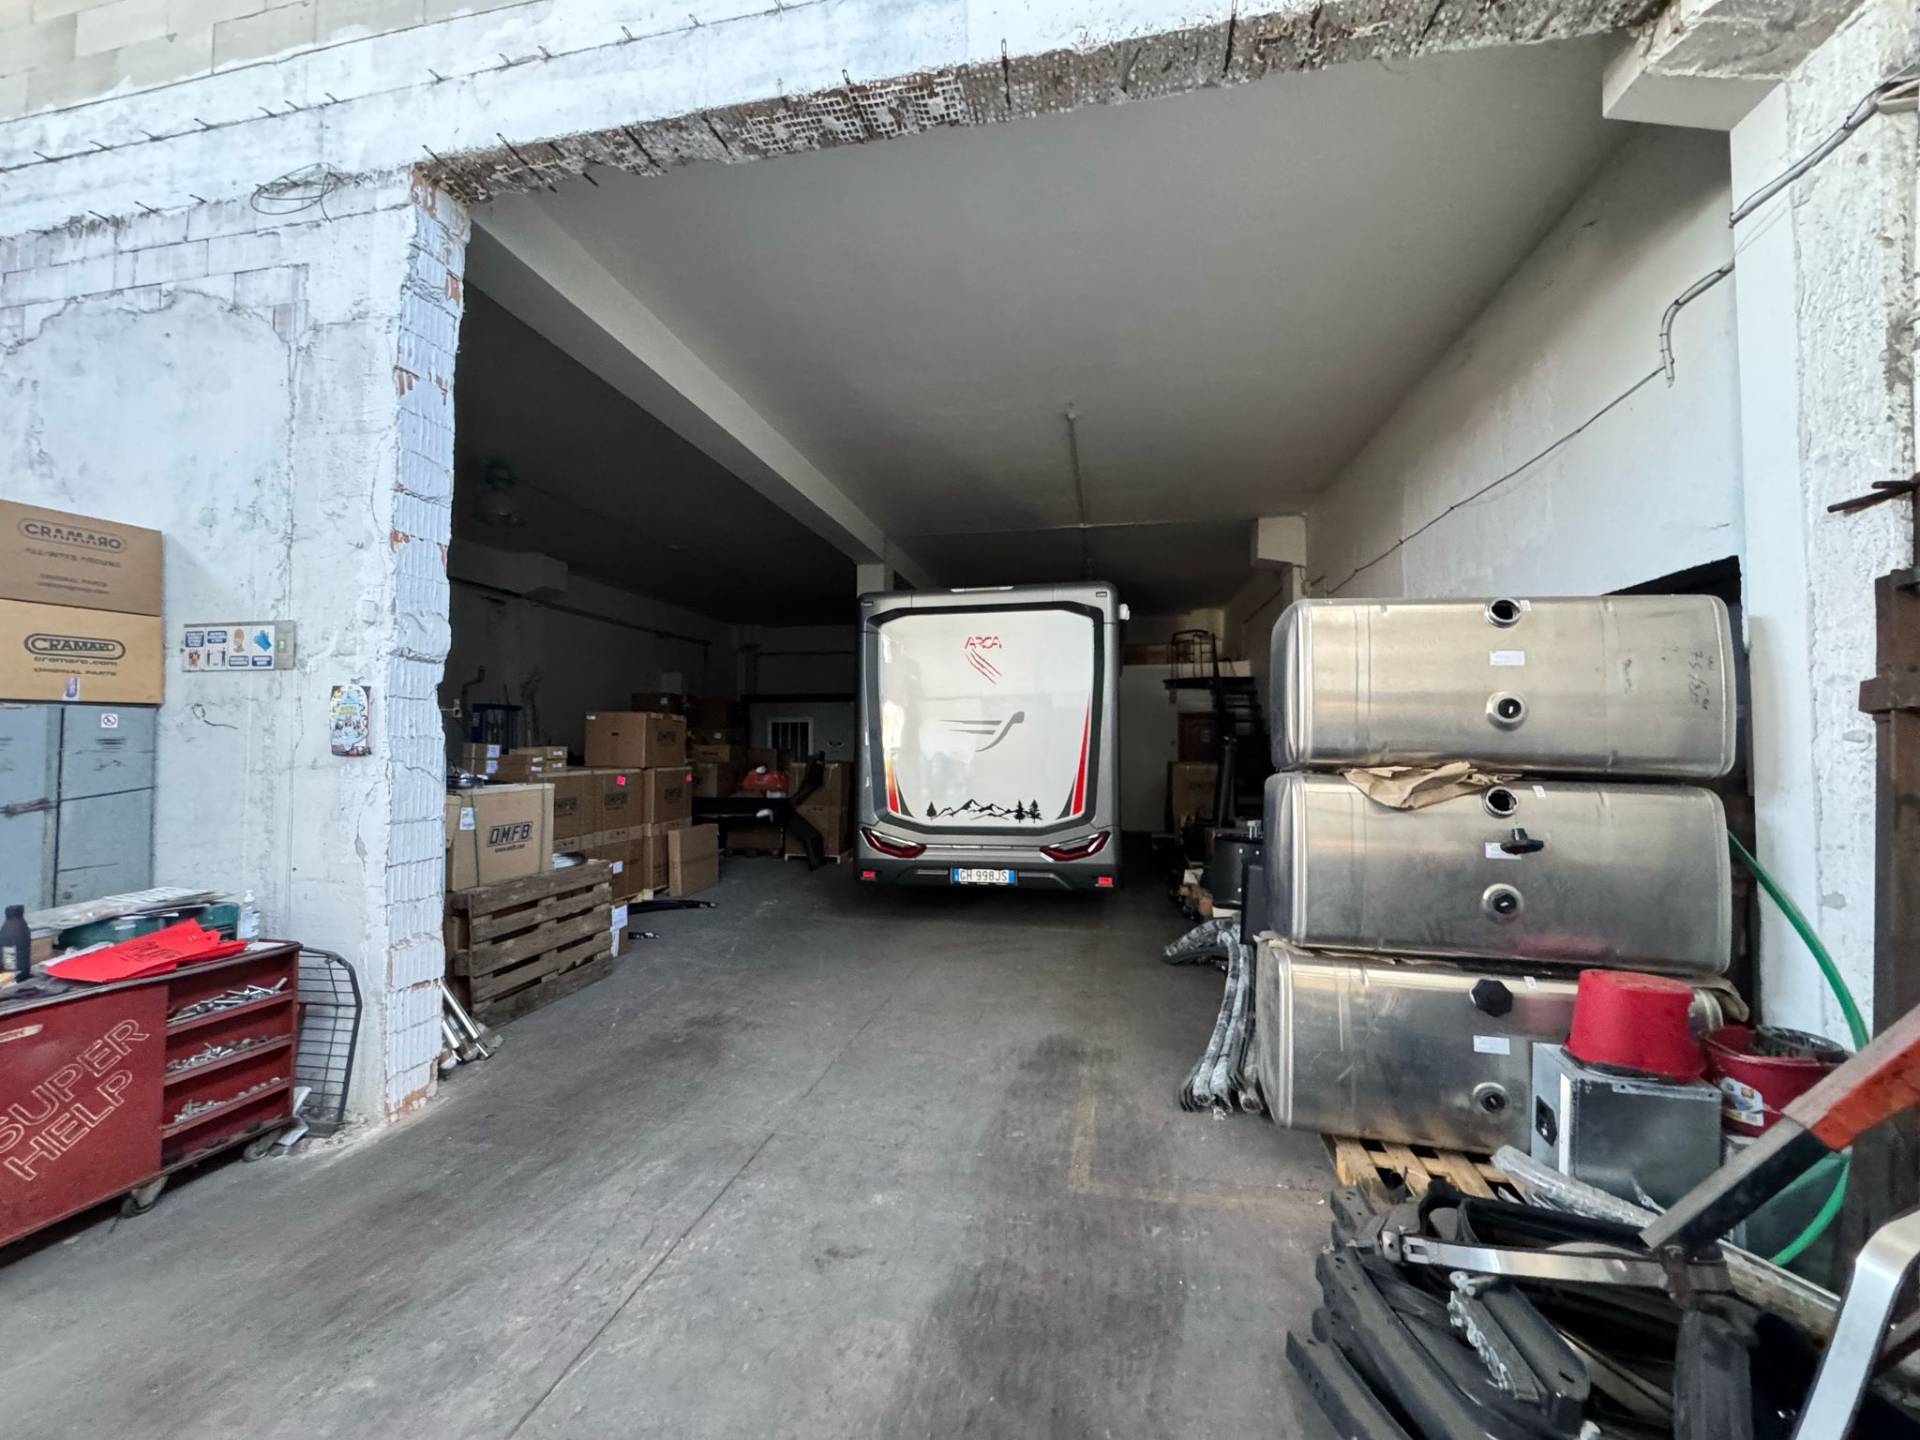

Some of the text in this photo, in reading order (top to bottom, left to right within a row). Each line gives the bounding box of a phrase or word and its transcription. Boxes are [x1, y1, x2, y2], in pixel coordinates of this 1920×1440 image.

[24, 523, 121, 549] CRAMARO
[31, 637, 116, 652] CRAMARO
[964, 636, 1002, 649] ARCA
[3, 1070, 133, 1181] HELP
